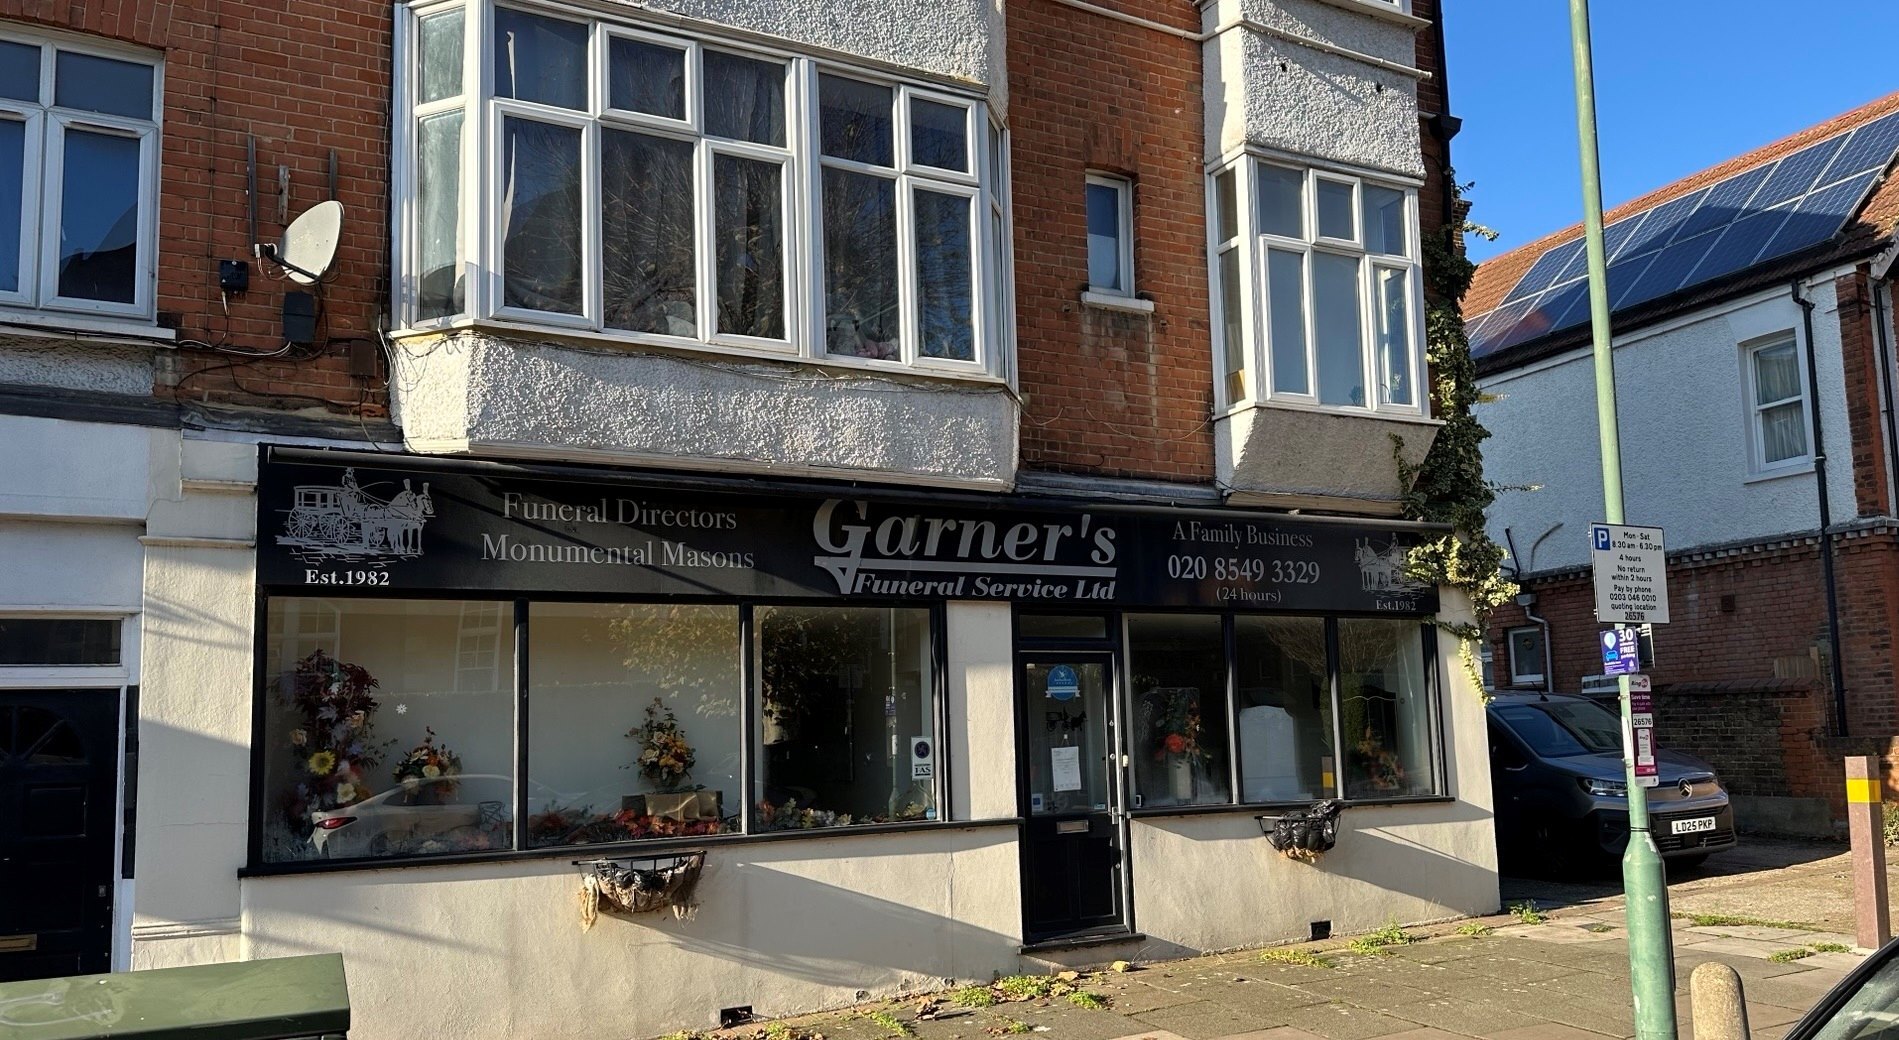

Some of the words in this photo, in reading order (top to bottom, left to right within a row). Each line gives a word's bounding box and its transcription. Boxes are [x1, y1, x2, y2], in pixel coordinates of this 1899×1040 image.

[503, 492, 608, 523] Funeral
[616, 499, 737, 529] Directors
[1172, 520, 1186, 540] A
[1190, 521, 1243, 549] Family
[1246, 525, 1313, 547] Business
[1623, 531, 1636, 539] Mon
[1640, 532, 1650, 540] Sat
[481, 533, 654, 566] Monumental
[662, 541, 754, 568] Masons
[813, 499, 1116, 594] Garner's
[1625, 554, 1641, 562] hours
[1168, 554, 1207, 579] 020
[1214, 557, 1265, 582] 8549
[1271, 560, 1320, 584] 3329
[1617, 564, 1625, 572] No
[304, 569, 389, 586] Est.1982
[1611, 573, 1629, 581] within
[1635, 574, 1652, 582] hours
[854, 573, 965, 596] Funeral
[972, 576, 1068, 598] Service
[1074, 579, 1116, 600] Ltd
[1613, 584, 1624, 593] Pay
[1625, 584, 1633, 593] by
[1634, 585, 1651, 593] phone
[1216, 587, 1237, 601] (24
[1240, 588, 1282, 603] hours)
[1627, 593, 1640, 601] 046
[1641, 594, 1656, 602] 0010
[1376, 600, 1416, 610] Est.1982
[1611, 602, 1632, 611] quoting
[1625, 611, 1645, 620] 26576
[1618, 628, 1633, 642] 30
[1620, 645, 1635, 654] FREE
[1634, 718, 1652, 726] 26576
[1676, 821, 1696, 832] LD25
[1698, 819, 1712, 829] PKP
